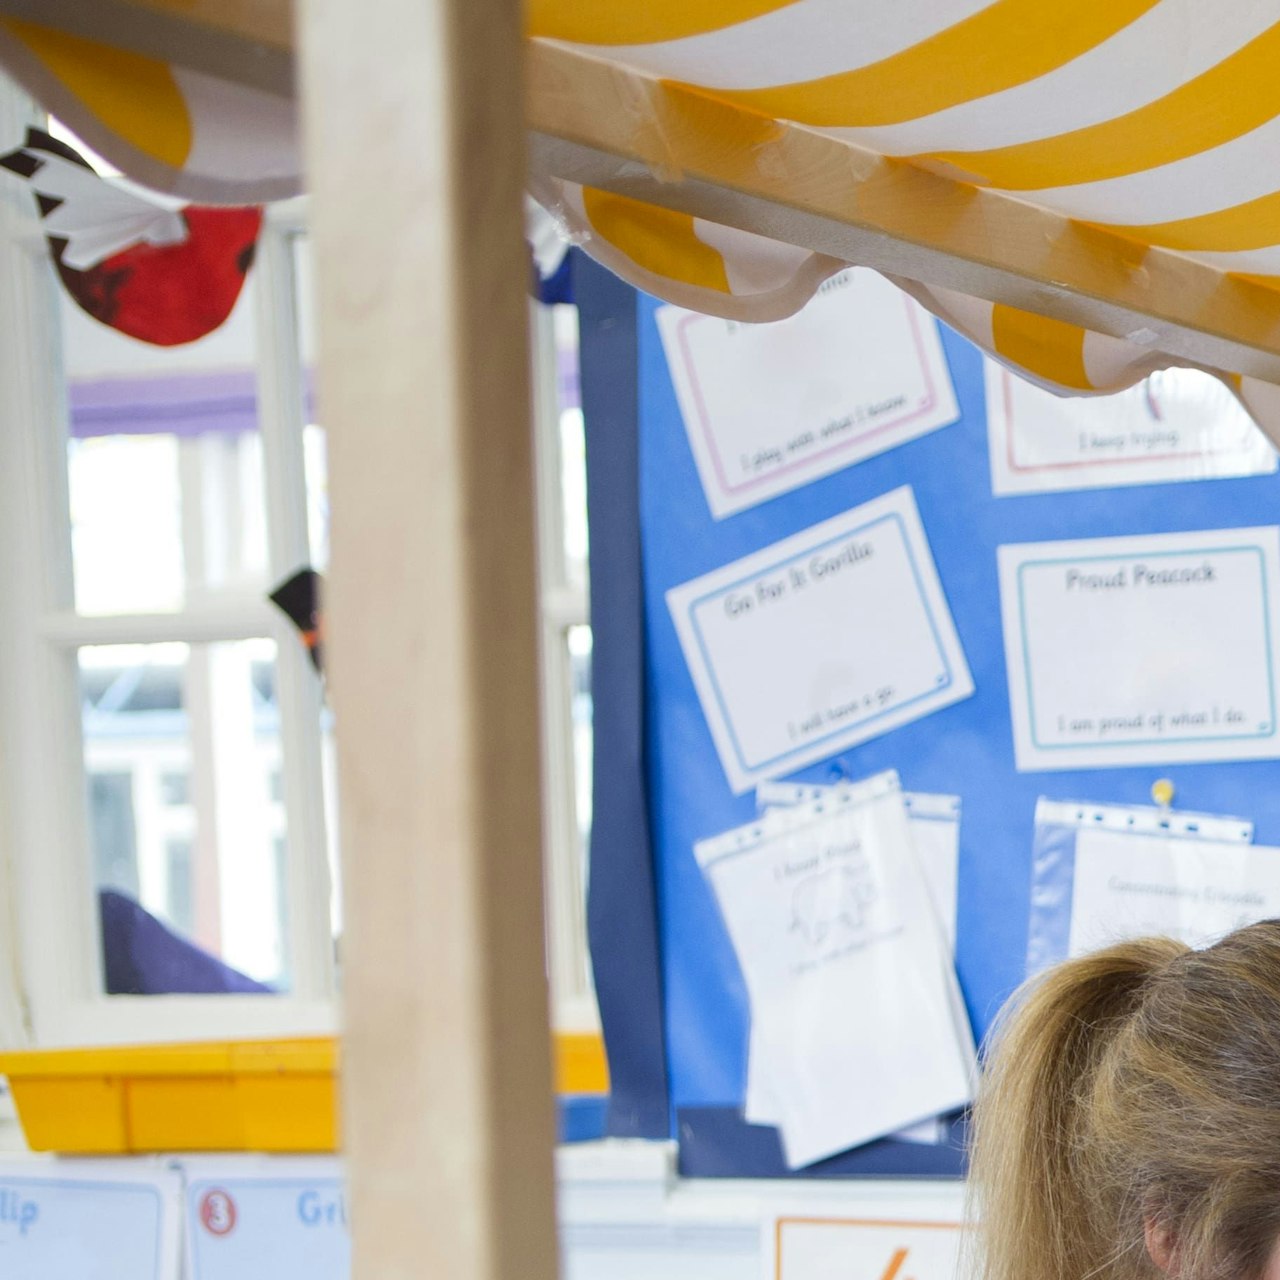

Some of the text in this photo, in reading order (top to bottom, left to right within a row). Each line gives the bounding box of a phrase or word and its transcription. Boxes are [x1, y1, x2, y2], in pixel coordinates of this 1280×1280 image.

[724, 592, 752, 620] Go
[809, 541, 875, 581] Gorilla
[1066, 561, 1215, 591] Proud Peacock
[1070, 717, 1094, 732] am
[1099, 711, 1144, 736] proud
[1149, 711, 1164, 734] of
